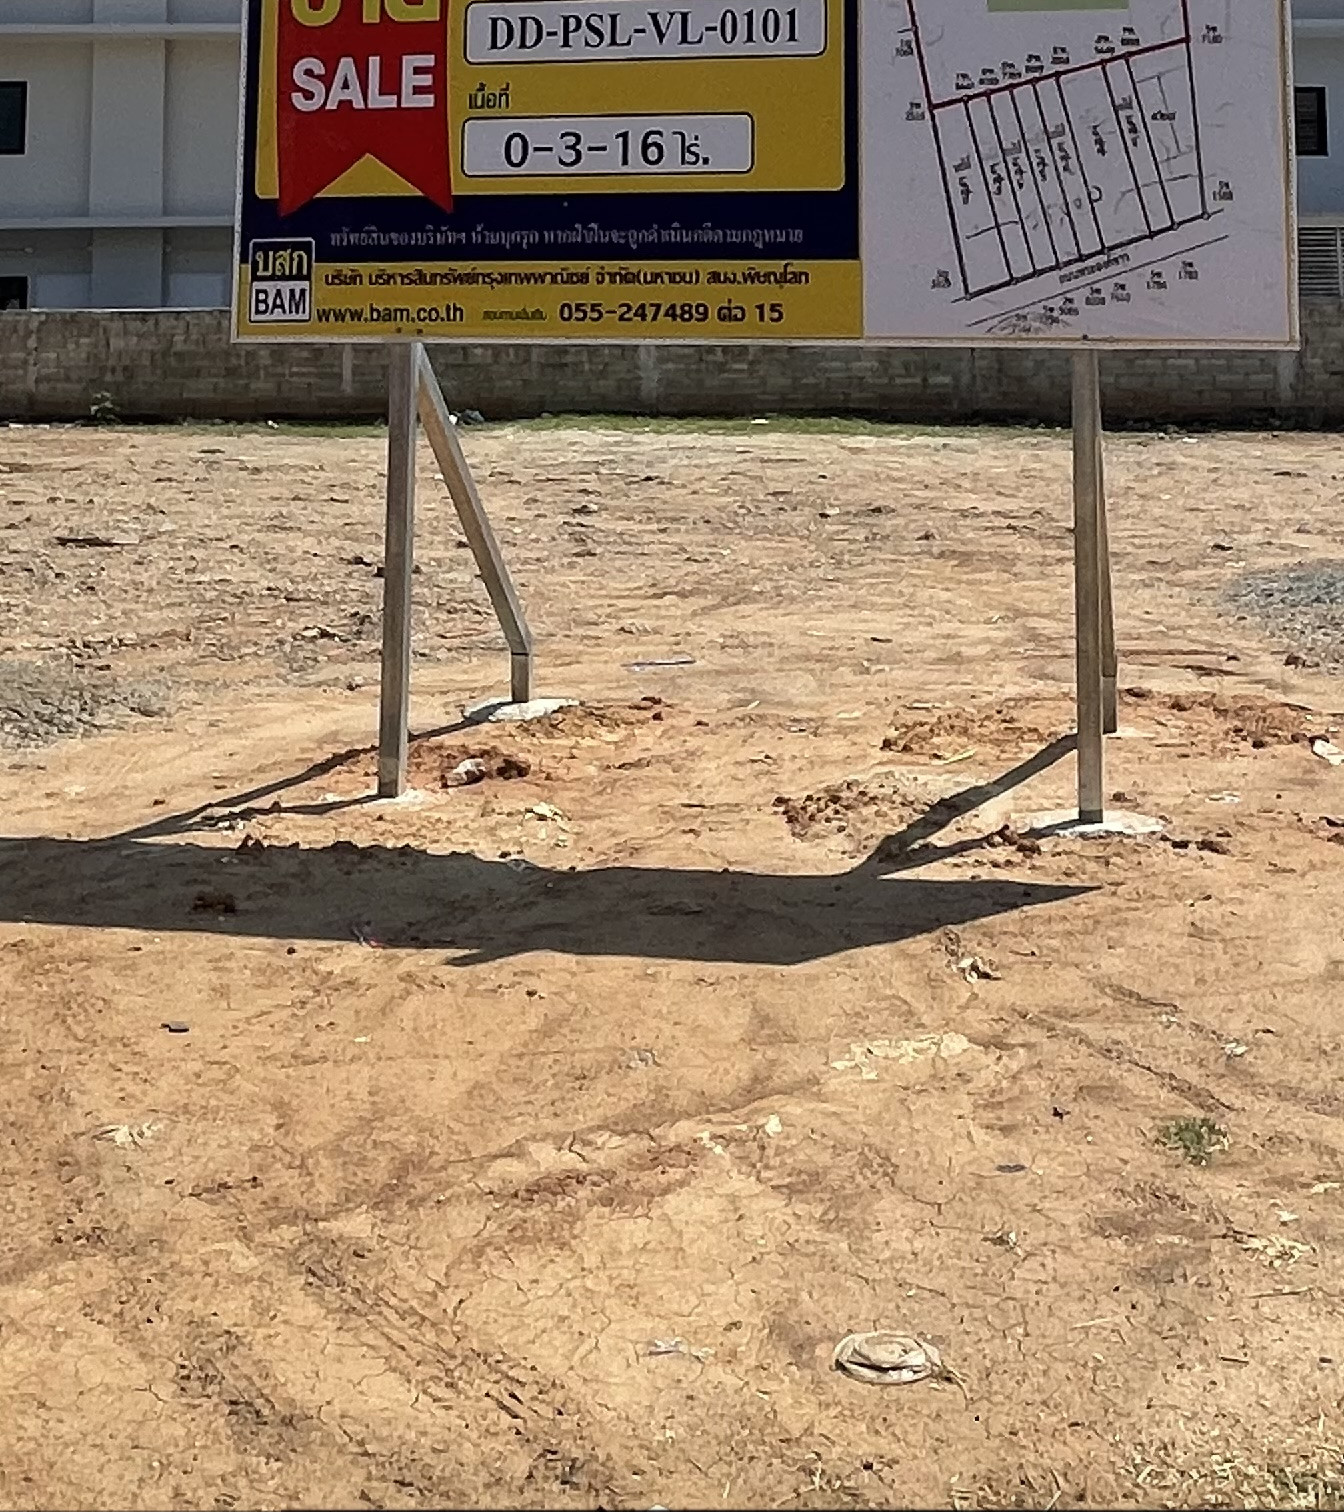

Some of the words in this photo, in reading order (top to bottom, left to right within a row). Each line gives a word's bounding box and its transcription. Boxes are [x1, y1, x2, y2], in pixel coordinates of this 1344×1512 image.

[487, 7, 800, 51] DD-PSL-VL-0101
[290, 54, 436, 112] SALE
[468, 82, 511, 110] เนื้อที่
[470, 223, 540, 250] ห้ามบุกรุก
[255, 247, 308, 277] บสก
[324, 268, 363, 286] บริษัท
[255, 288, 307, 316] BAM
[316, 303, 464, 323] www.bam.co.th
[558, 302, 710, 323] 055-247489
[716, 298, 746, 323] ต่อ
[754, 302, 784, 323] 15
